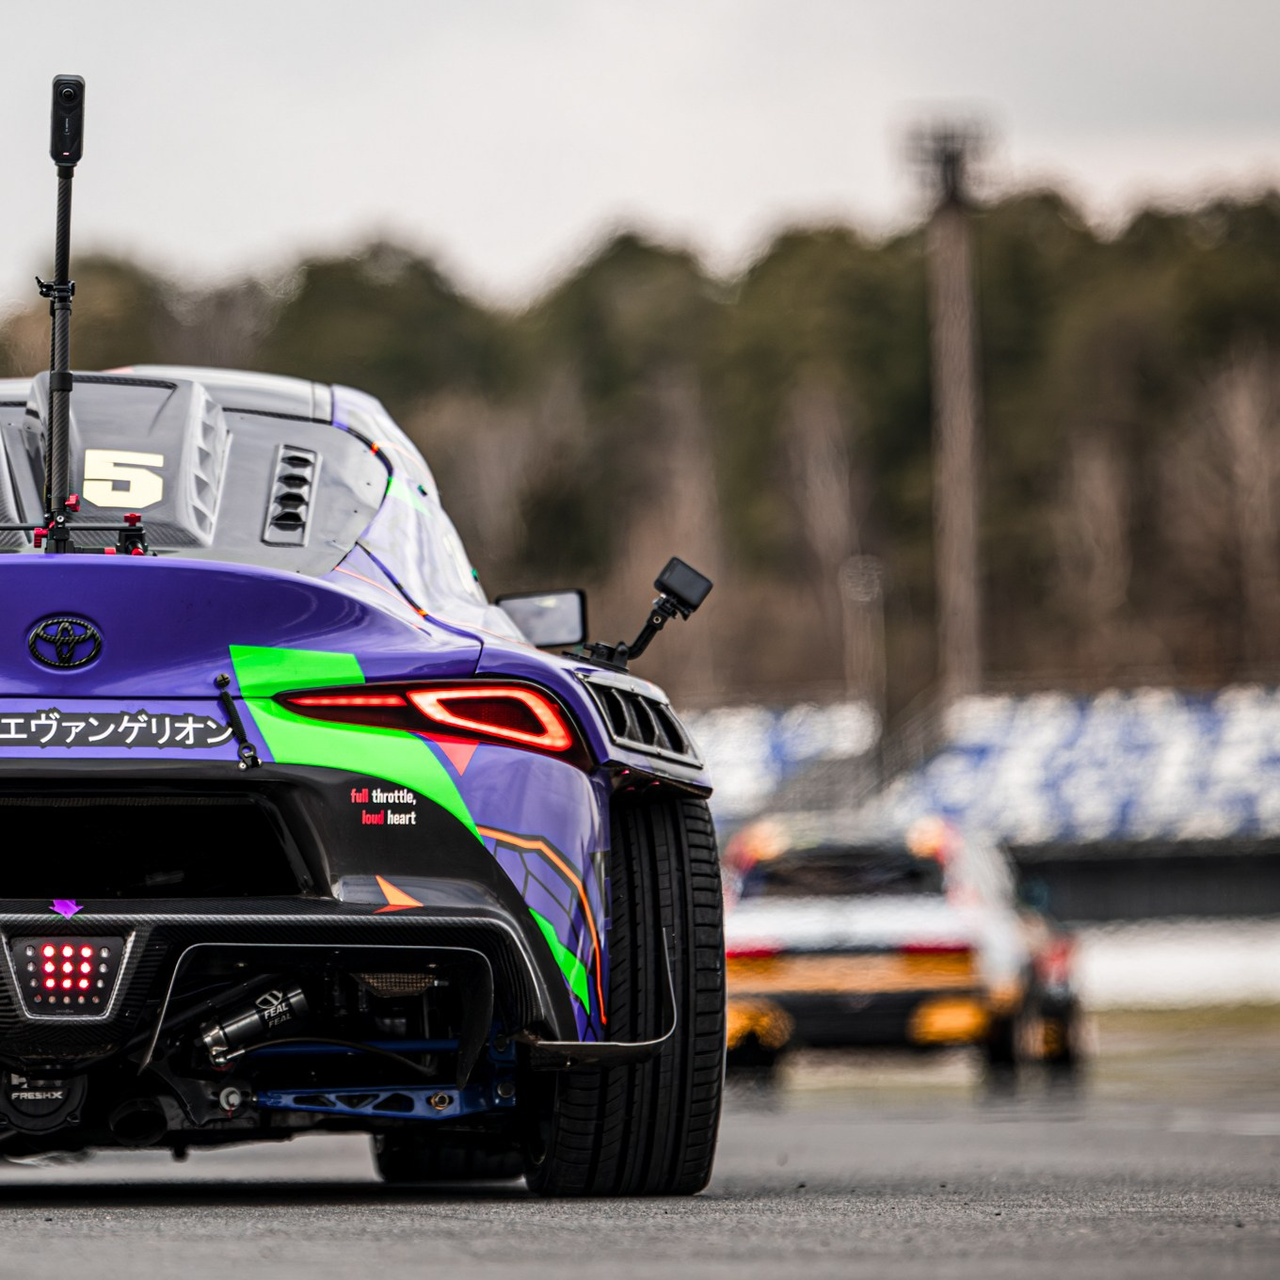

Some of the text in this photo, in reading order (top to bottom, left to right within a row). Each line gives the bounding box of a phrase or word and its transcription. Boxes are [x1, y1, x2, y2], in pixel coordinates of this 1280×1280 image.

[351, 787, 417, 806] full throttle,
[362, 809, 417, 825] loud heart
[264, 1003, 289, 1020] FEAL
[268, 1013, 292, 1029] FEAL
